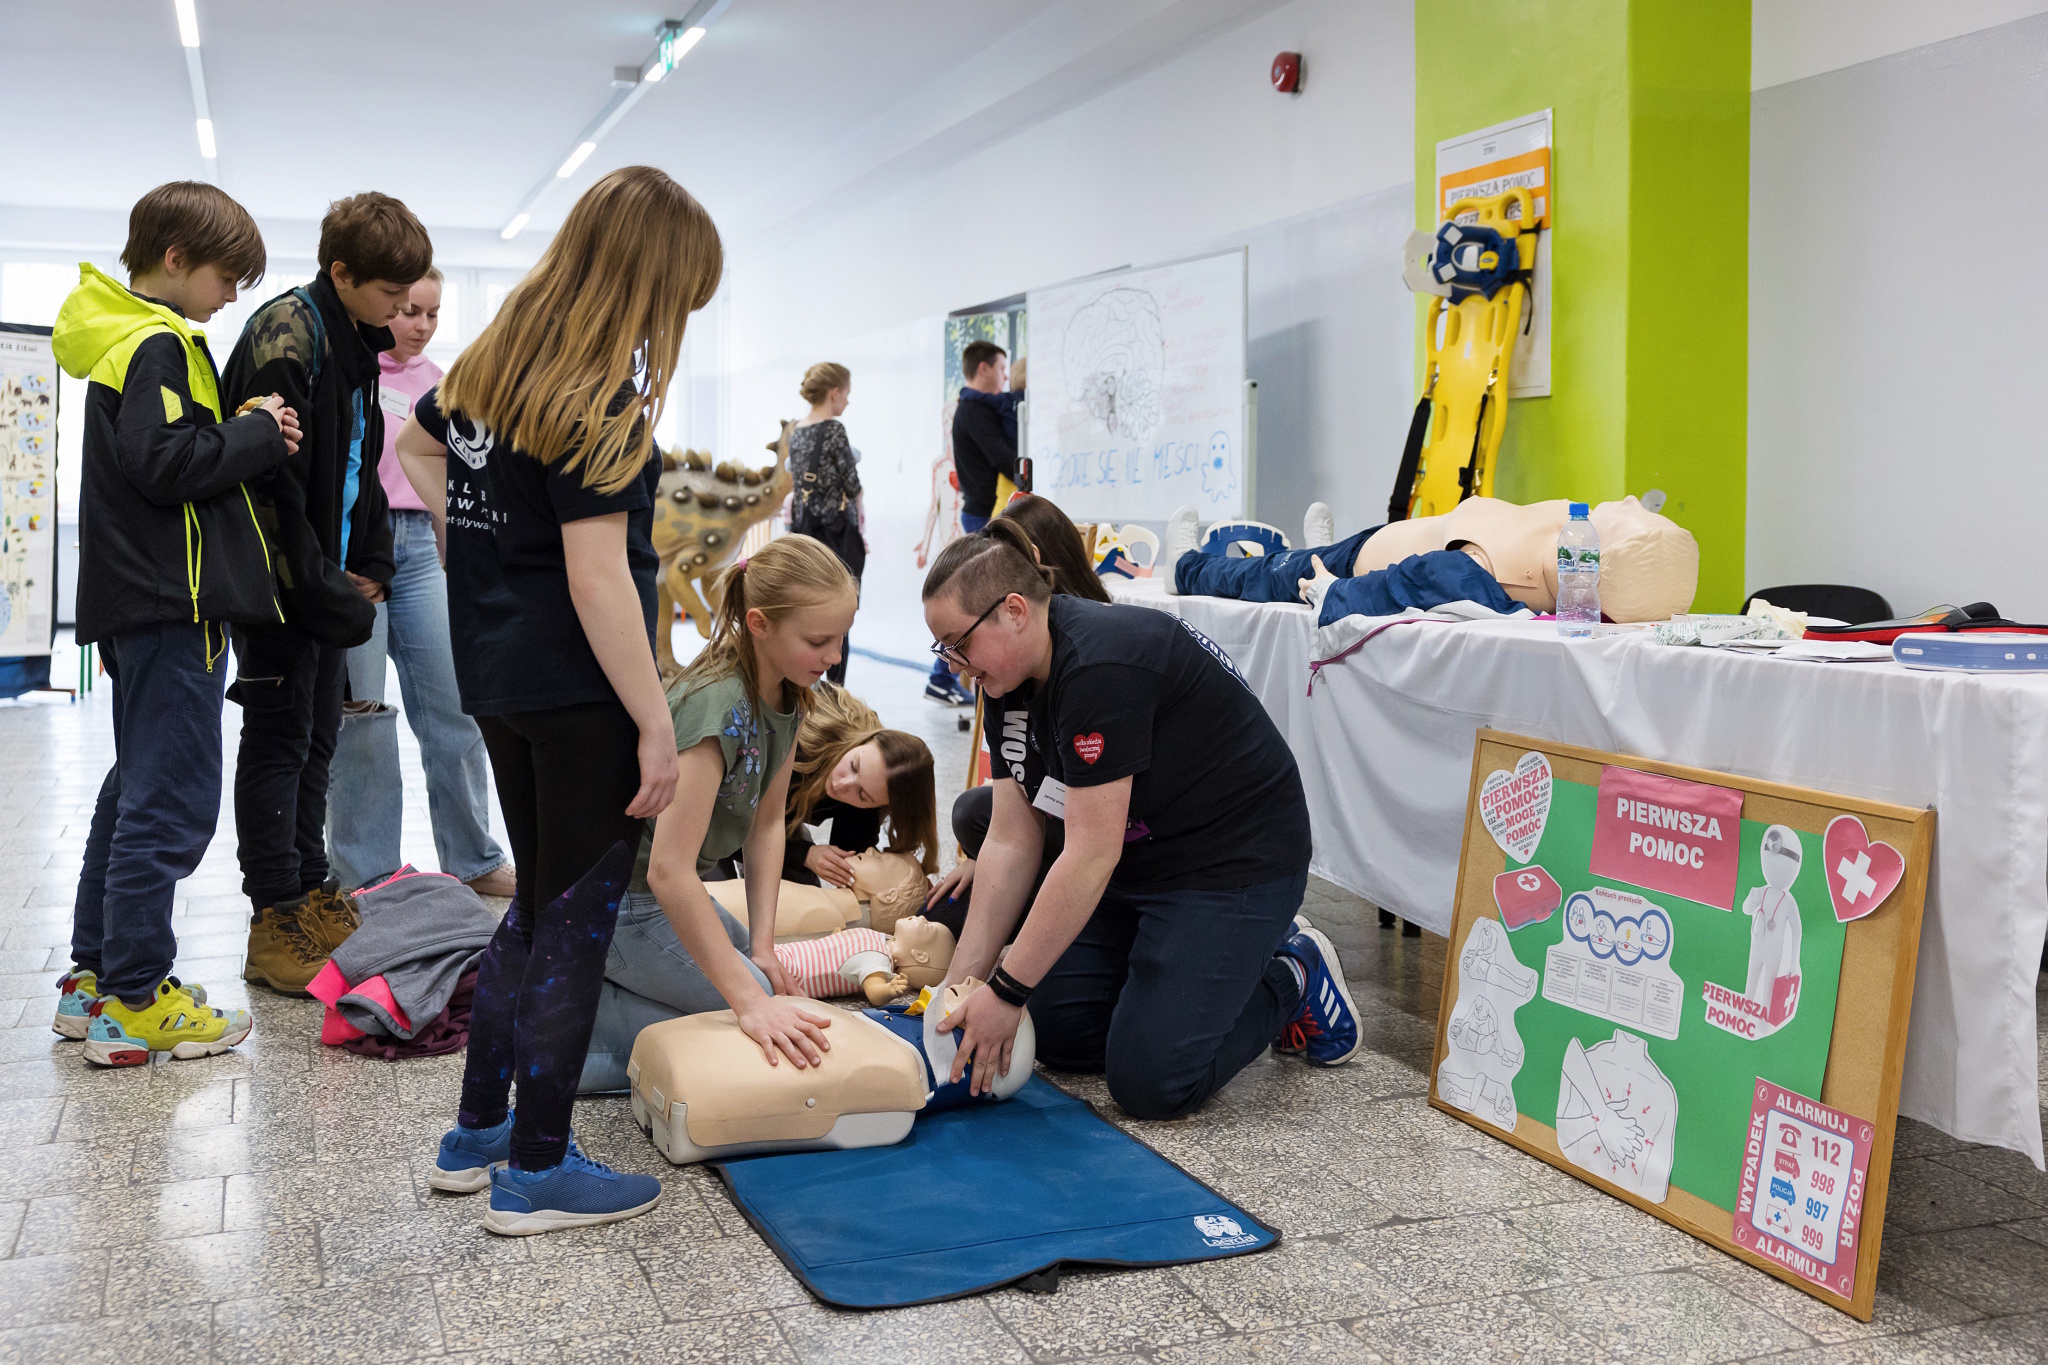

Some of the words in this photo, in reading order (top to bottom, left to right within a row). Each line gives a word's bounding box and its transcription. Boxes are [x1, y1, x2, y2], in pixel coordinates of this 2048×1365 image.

[1502, 172, 1535, 191] POMOC
[448, 479, 486, 501] KLB
[1482, 765, 1549, 810] PIERWSZA
[1540, 782, 1551, 792] AED
[1495, 785, 1540, 819] POMOC
[1488, 816, 1497, 825] 112
[1505, 805, 1536, 829] MOGĘ
[1617, 797, 1722, 841] PIERWSZA
[1506, 818, 1541, 845] POMÓC
[1629, 832, 1704, 869] POMOC
[1702, 982, 1768, 1022] PIERWSZA
[1708, 1006, 1756, 1038] POMOC
[1776, 1093, 1848, 1134] ALARMUJ
[1739, 1112, 1765, 1213] WYPADEK
[1779, 1158, 1795, 1169] STRAŻ
[1812, 1136, 1841, 1166] 112
[1772, 1183, 1792, 1196] POLICJA
[1810, 1170, 1835, 1196] 998
[1805, 1197, 1829, 1222] 997
[1840, 1167, 1864, 1248] POŻAR
[1802, 1225, 1823, 1251] 999
[1755, 1236, 1827, 1282] ALARMUJ
